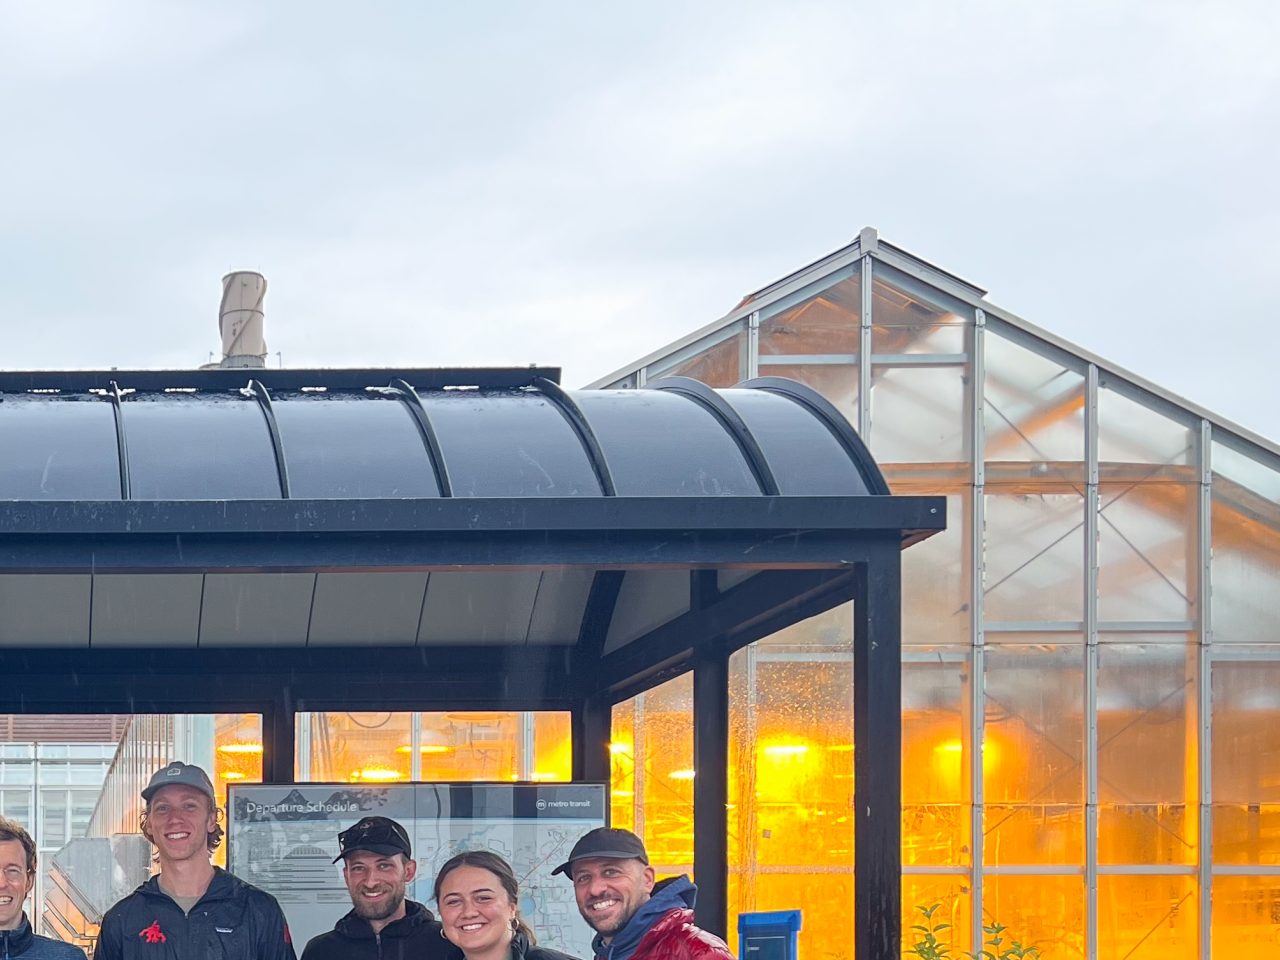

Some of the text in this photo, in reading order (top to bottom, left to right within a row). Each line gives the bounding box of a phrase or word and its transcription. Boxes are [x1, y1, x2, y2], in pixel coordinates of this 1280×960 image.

[246, 801, 358, 815] Departure Schedule
[548, 800, 569, 808] metro
[570, 800, 591, 808] transit
